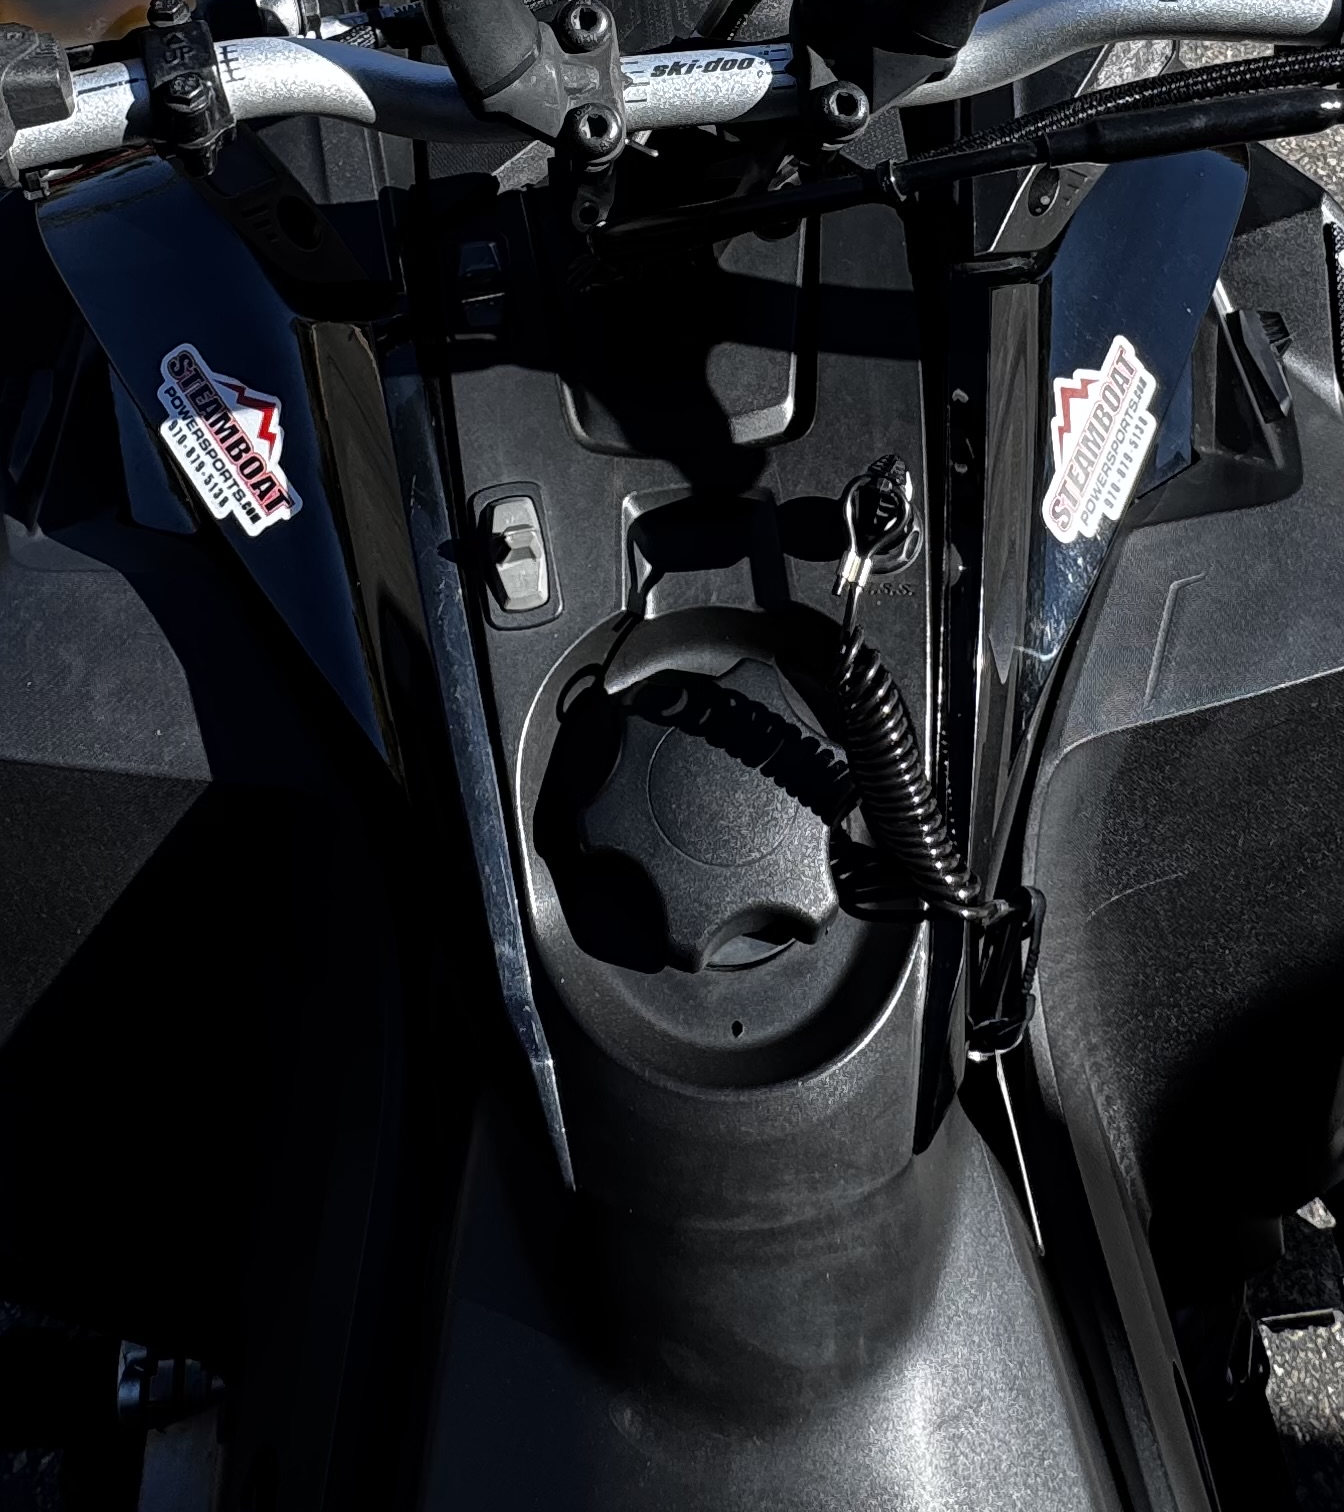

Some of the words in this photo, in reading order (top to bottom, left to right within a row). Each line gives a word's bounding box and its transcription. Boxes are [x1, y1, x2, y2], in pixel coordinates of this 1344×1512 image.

[650, 57, 756, 78] ski-doo
[167, 351, 296, 517] STEAMBOAT
[1049, 345, 1138, 532] STEAMBOAT
